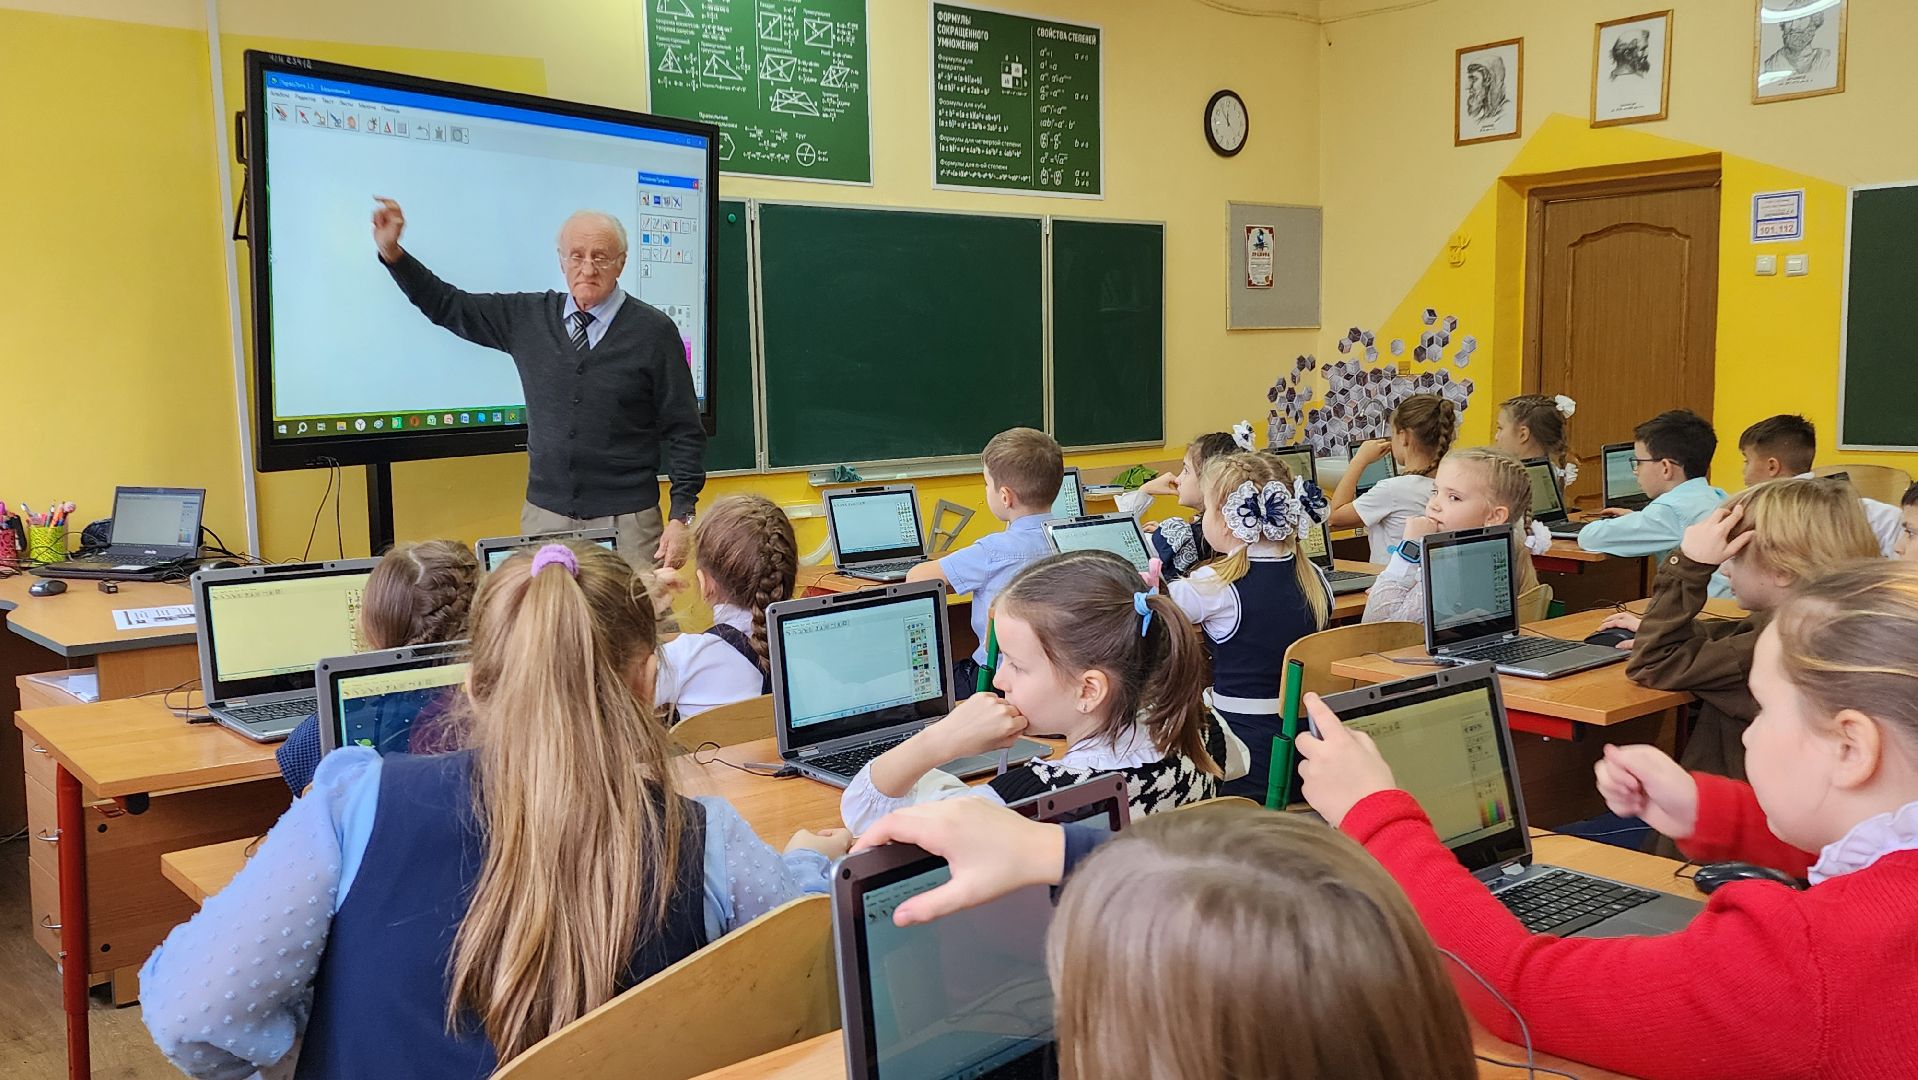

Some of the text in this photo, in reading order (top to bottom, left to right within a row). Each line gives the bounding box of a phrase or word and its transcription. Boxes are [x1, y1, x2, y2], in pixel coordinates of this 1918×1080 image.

[937, 10, 972, 26] ФОРМУЛЫ
[937, 24, 989, 40] СОКРАЩЕННОГО
[1037, 27, 1096, 45] СВОЙСТВА СТЕПЕНЕЙ
[937, 36, 978, 52] УМНОЖЕНИЯ
